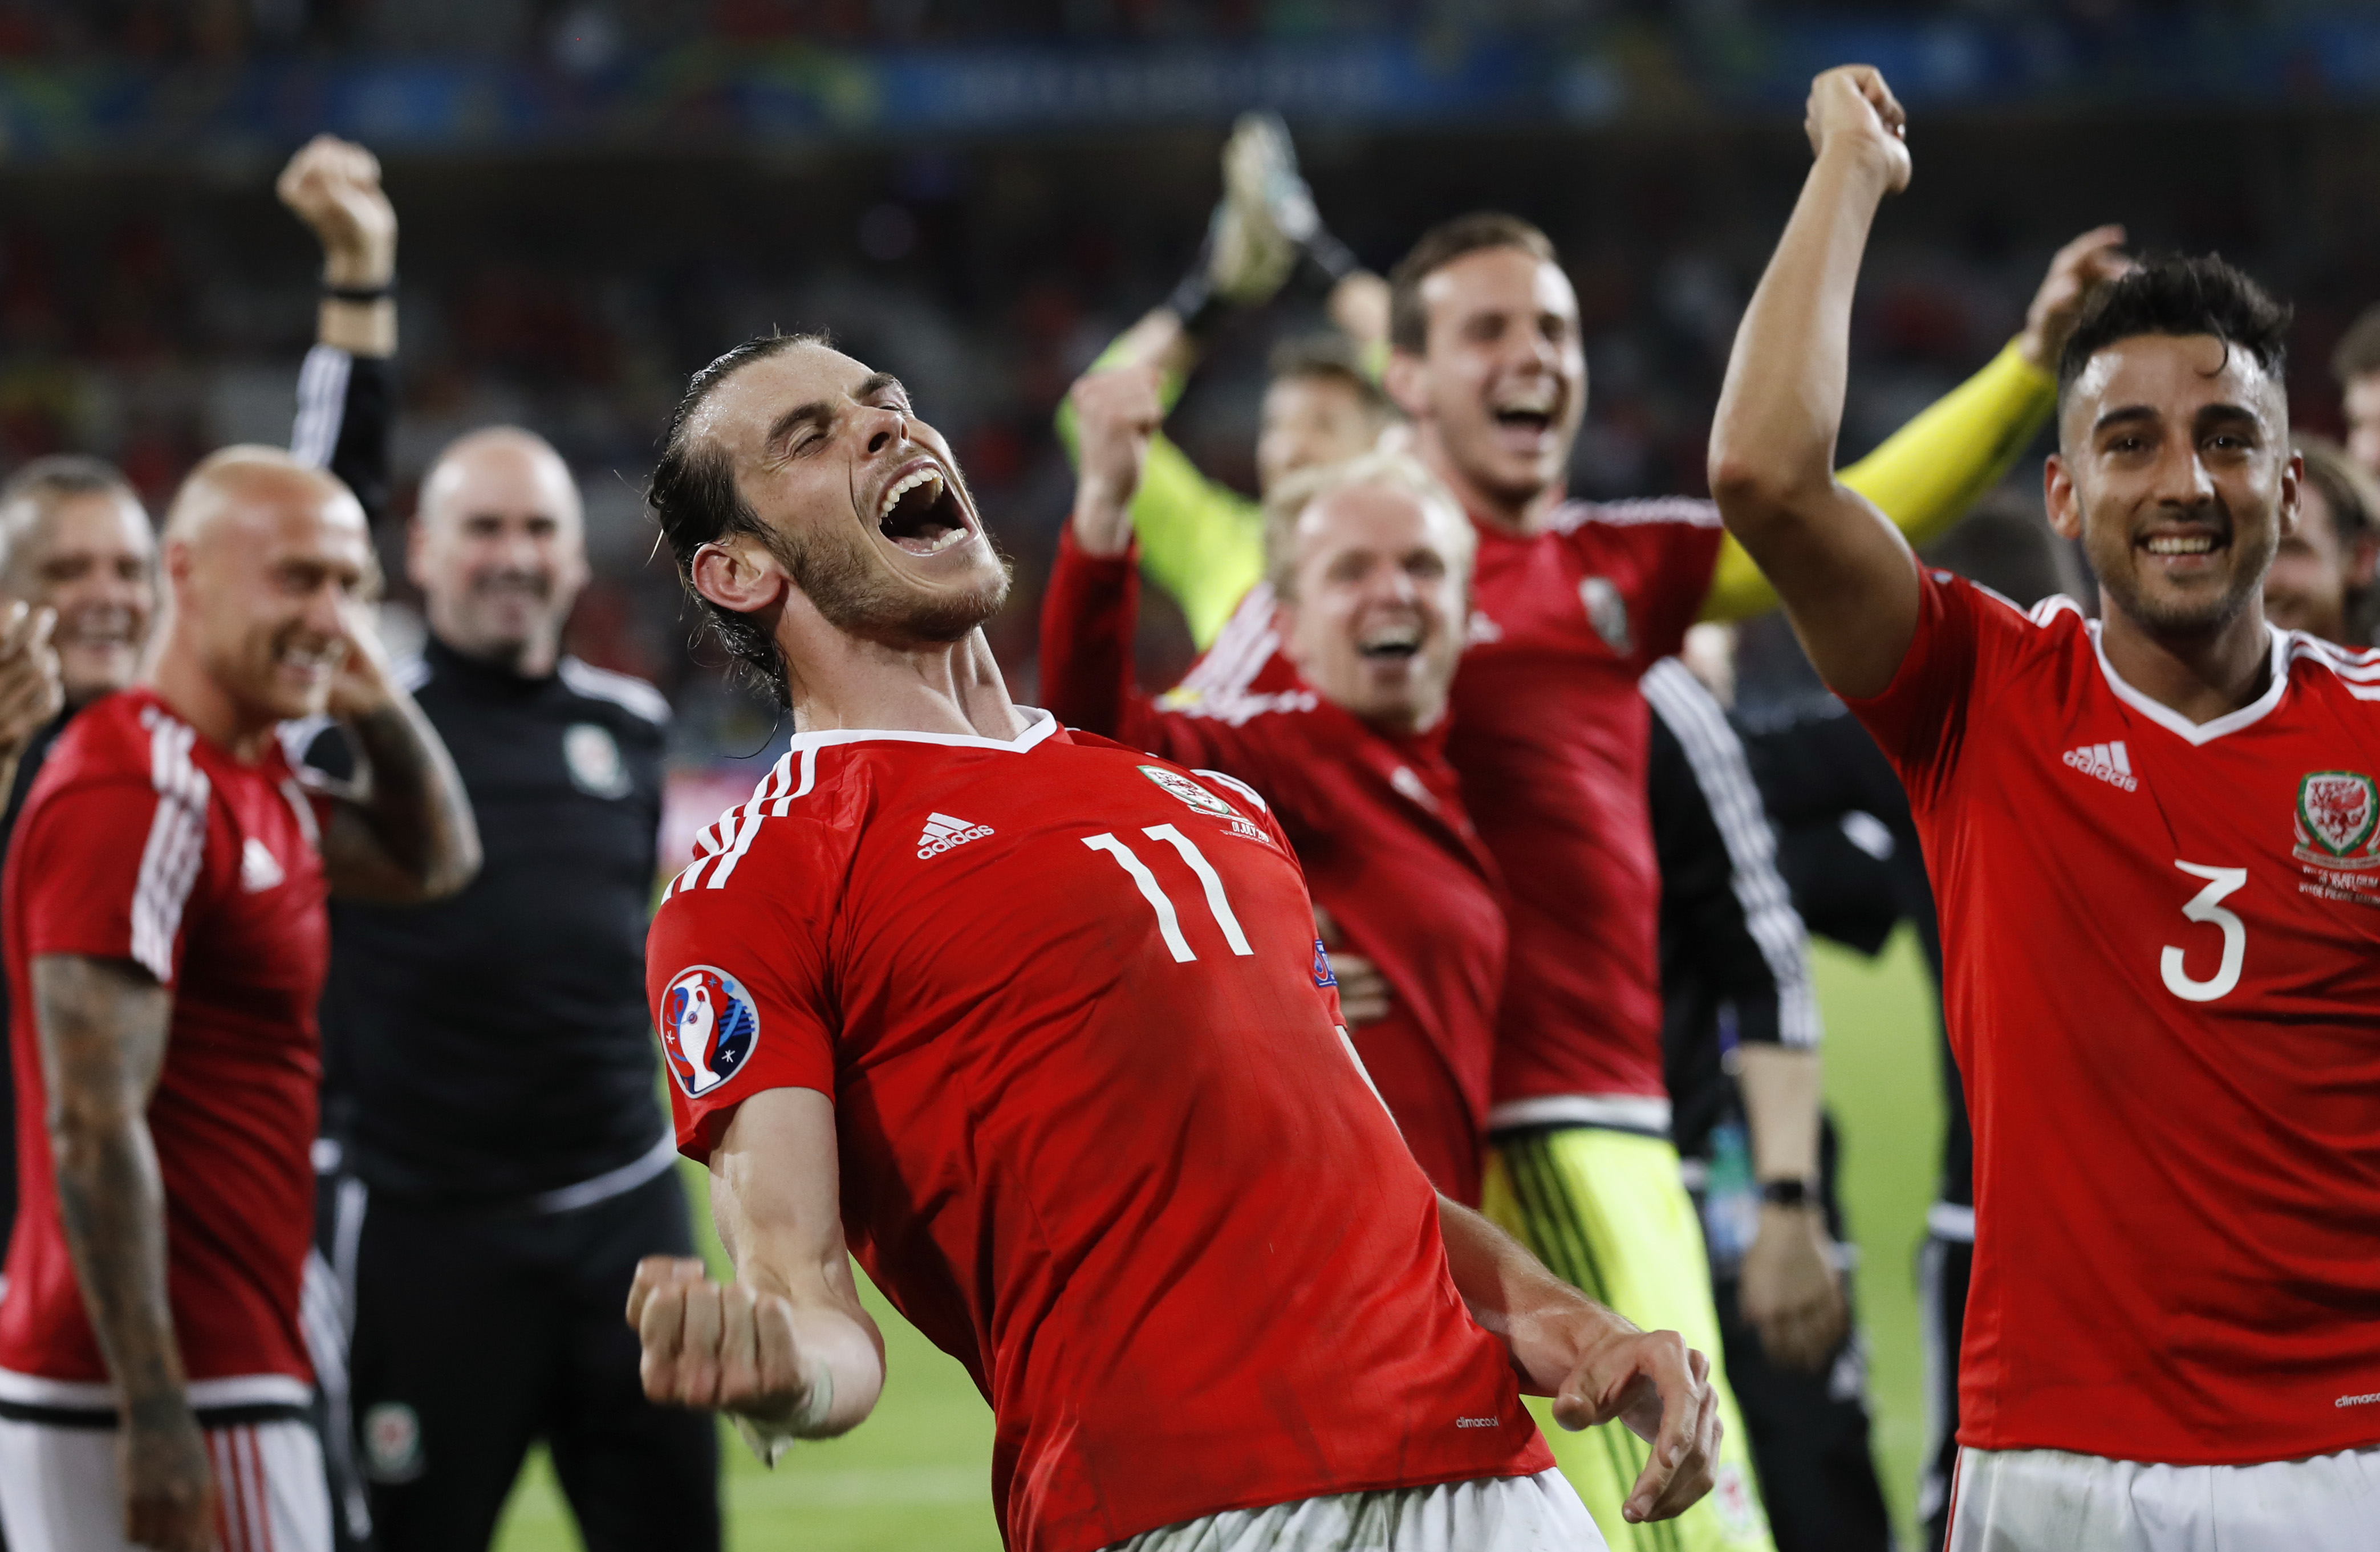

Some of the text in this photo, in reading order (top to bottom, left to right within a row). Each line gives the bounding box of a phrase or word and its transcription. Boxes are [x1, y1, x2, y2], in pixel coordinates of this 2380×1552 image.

[2062, 750, 2138, 793] adidas
[917, 825, 994, 859] adidas
[1240, 823, 1256, 837] JULY
[1081, 823, 1254, 964] 11
[2160, 858, 2247, 1002] 3
[1456, 1415, 1499, 1428] climacool
